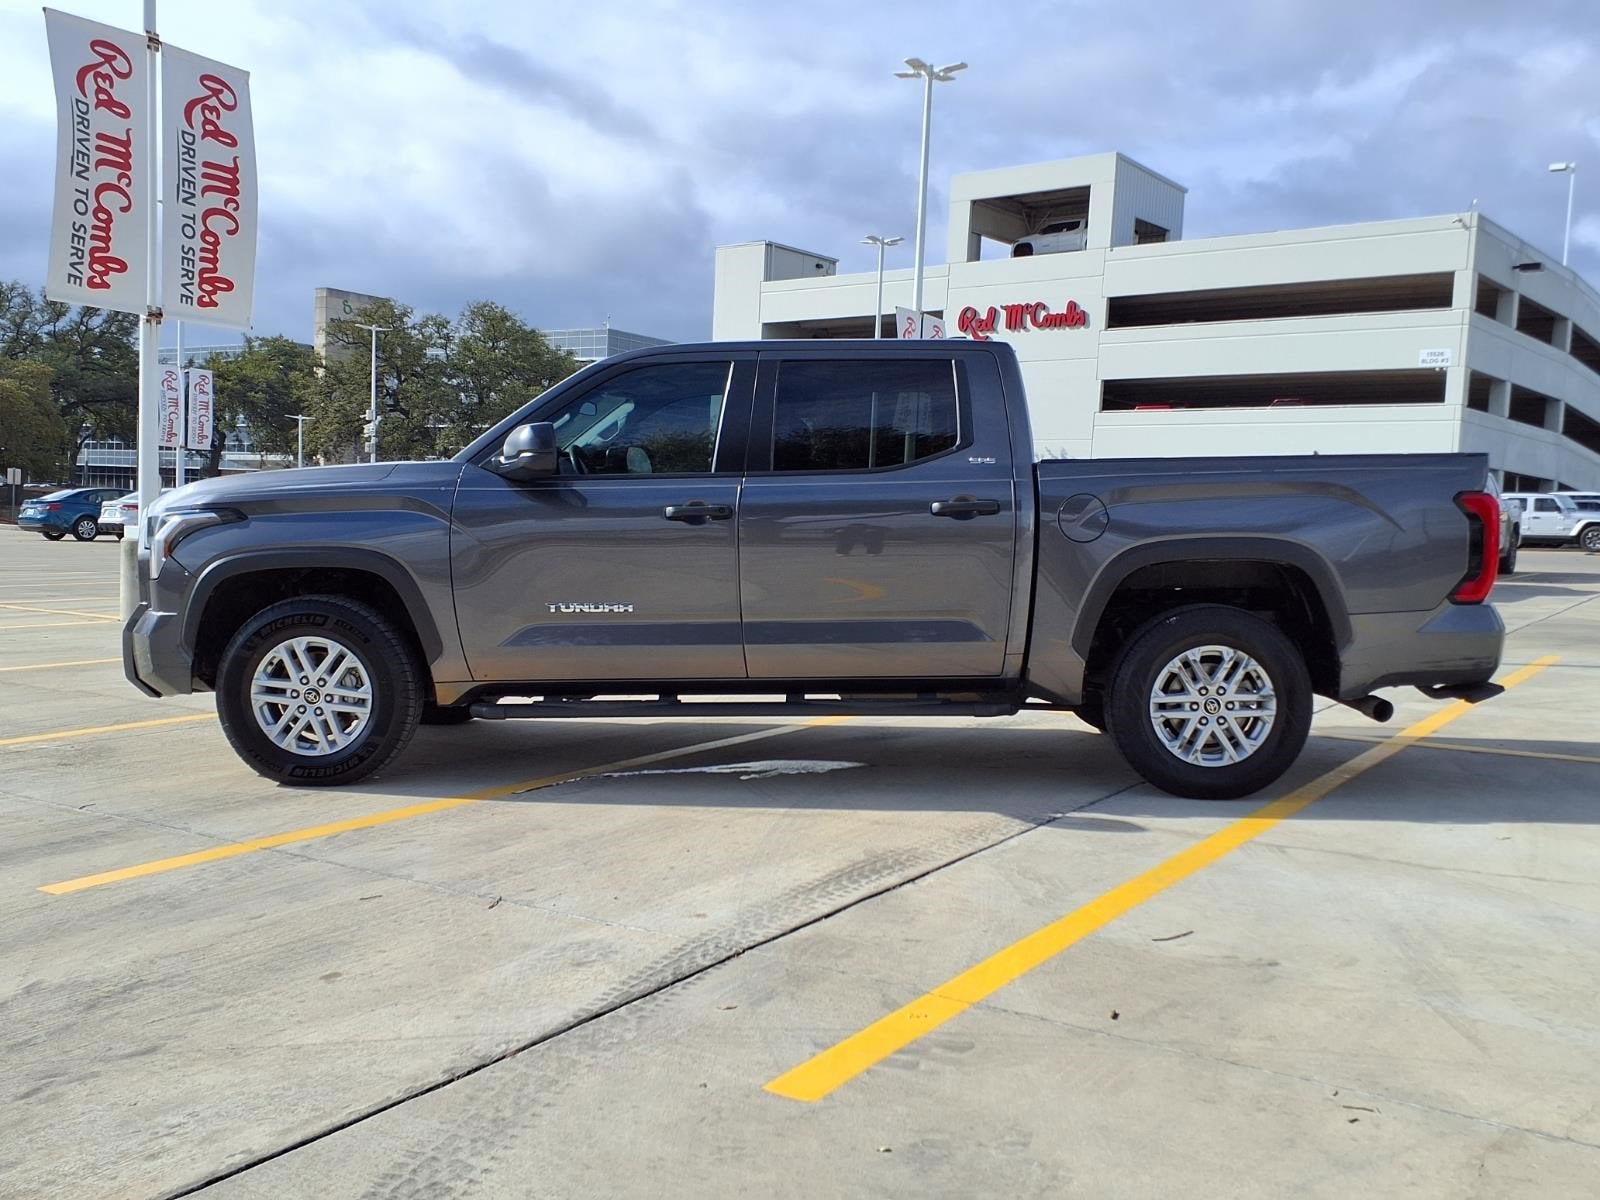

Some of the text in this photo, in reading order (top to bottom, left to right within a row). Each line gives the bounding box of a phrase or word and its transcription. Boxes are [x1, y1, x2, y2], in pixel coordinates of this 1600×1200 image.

[67, 97, 91, 287] DRIVEN TO SERVE
[75, 39, 133, 290] Red McCombs
[183, 73, 241, 308] Red McCombs
[179, 129, 196, 306] DRIVEN TO SERVE
[957, 305, 997, 341] Red
[1000, 299, 1086, 330] McCombs
[161, 370, 179, 443] Red McCombs
[194, 374, 210, 444] Red McCombs
[260, 614, 326, 638] MICHELIN
[544, 602, 634, 613] TUNDRA
